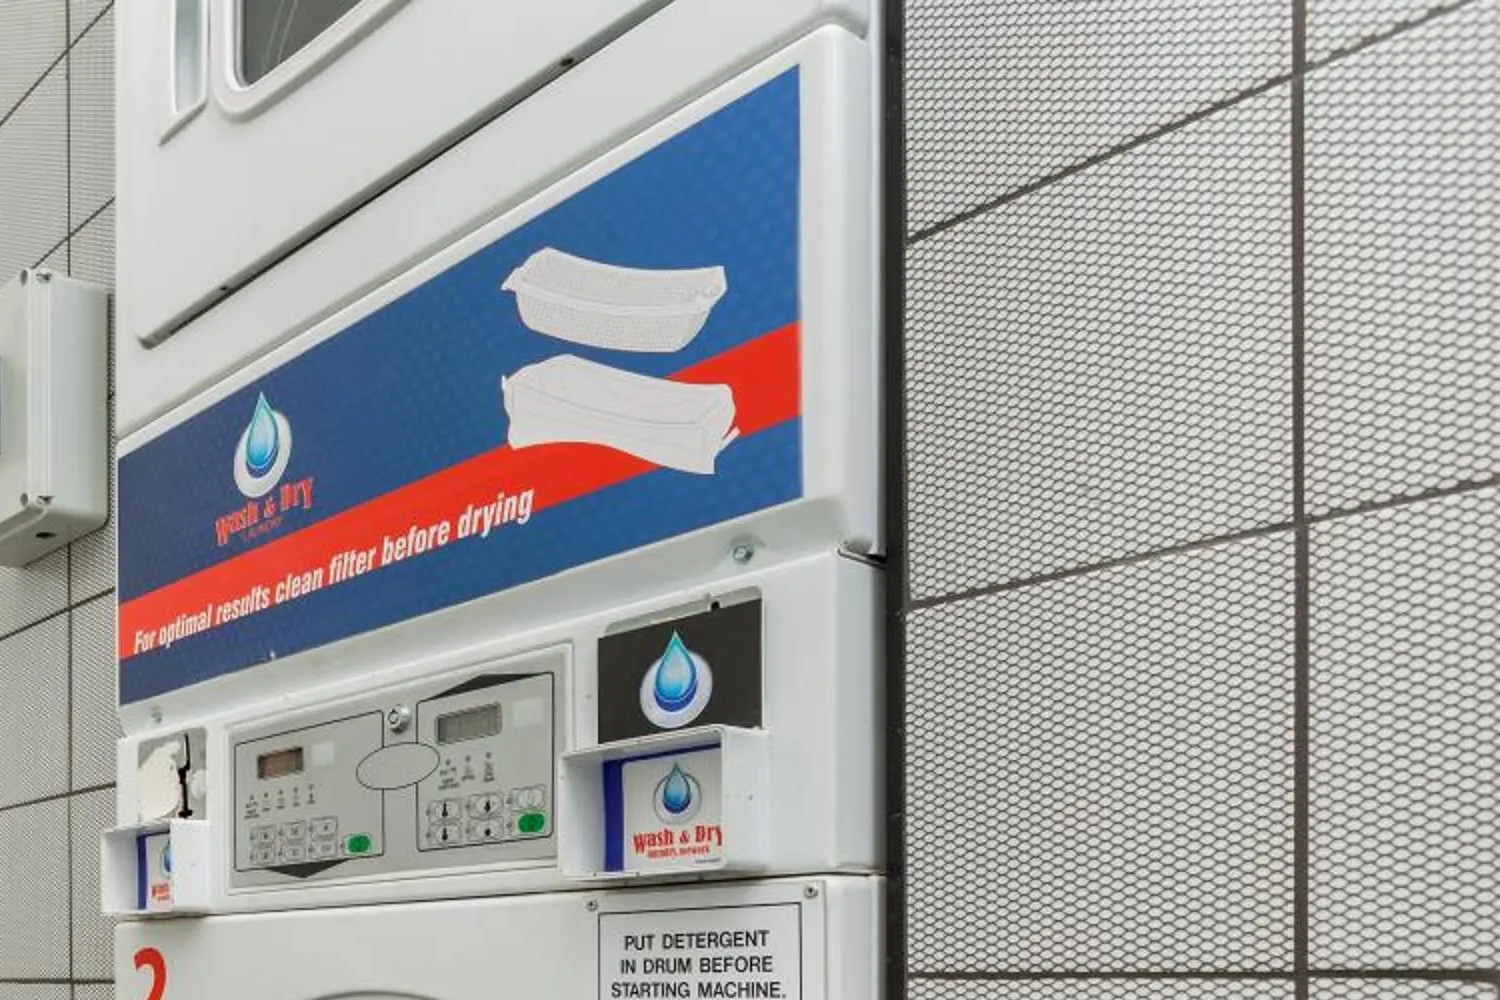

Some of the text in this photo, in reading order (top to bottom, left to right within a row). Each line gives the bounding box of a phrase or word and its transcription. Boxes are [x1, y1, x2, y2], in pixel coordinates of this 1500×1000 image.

[215, 499, 259, 546] Wash
[263, 496, 276, 518] &
[133, 487, 535, 654] For optimal results clean filter before drying
[632, 825, 722, 855] Wash & Dry
[624, 930, 770, 951] PUT DETERGENT
[620, 955, 773, 974] IN DRUM BEFORE
[611, 981, 786, 999] STARTING MACHINE.
